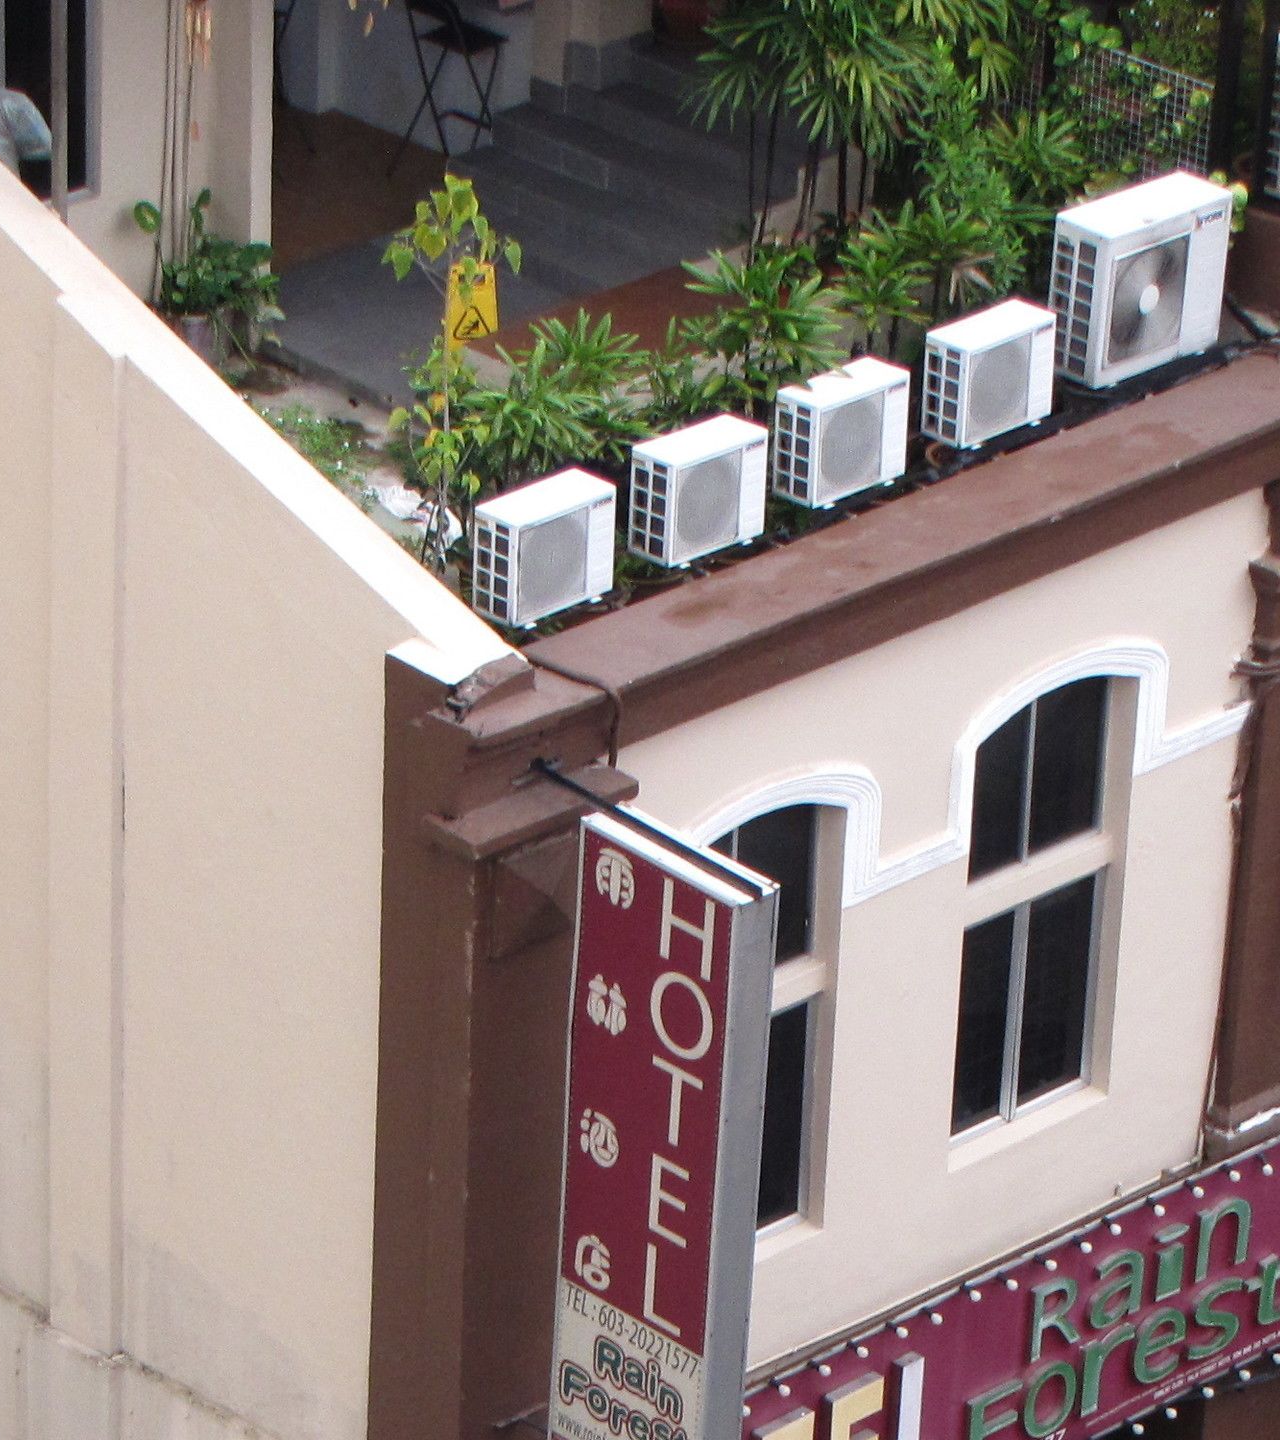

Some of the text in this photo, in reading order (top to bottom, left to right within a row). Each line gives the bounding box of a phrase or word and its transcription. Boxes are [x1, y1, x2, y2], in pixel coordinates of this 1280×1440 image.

[644, 877, 716, 1338] HOTEL
[598, 1304, 700, 1379] 603-20221577
[1031, 1198, 1253, 1363] Rain
[594, 1335, 683, 1424] Rain
